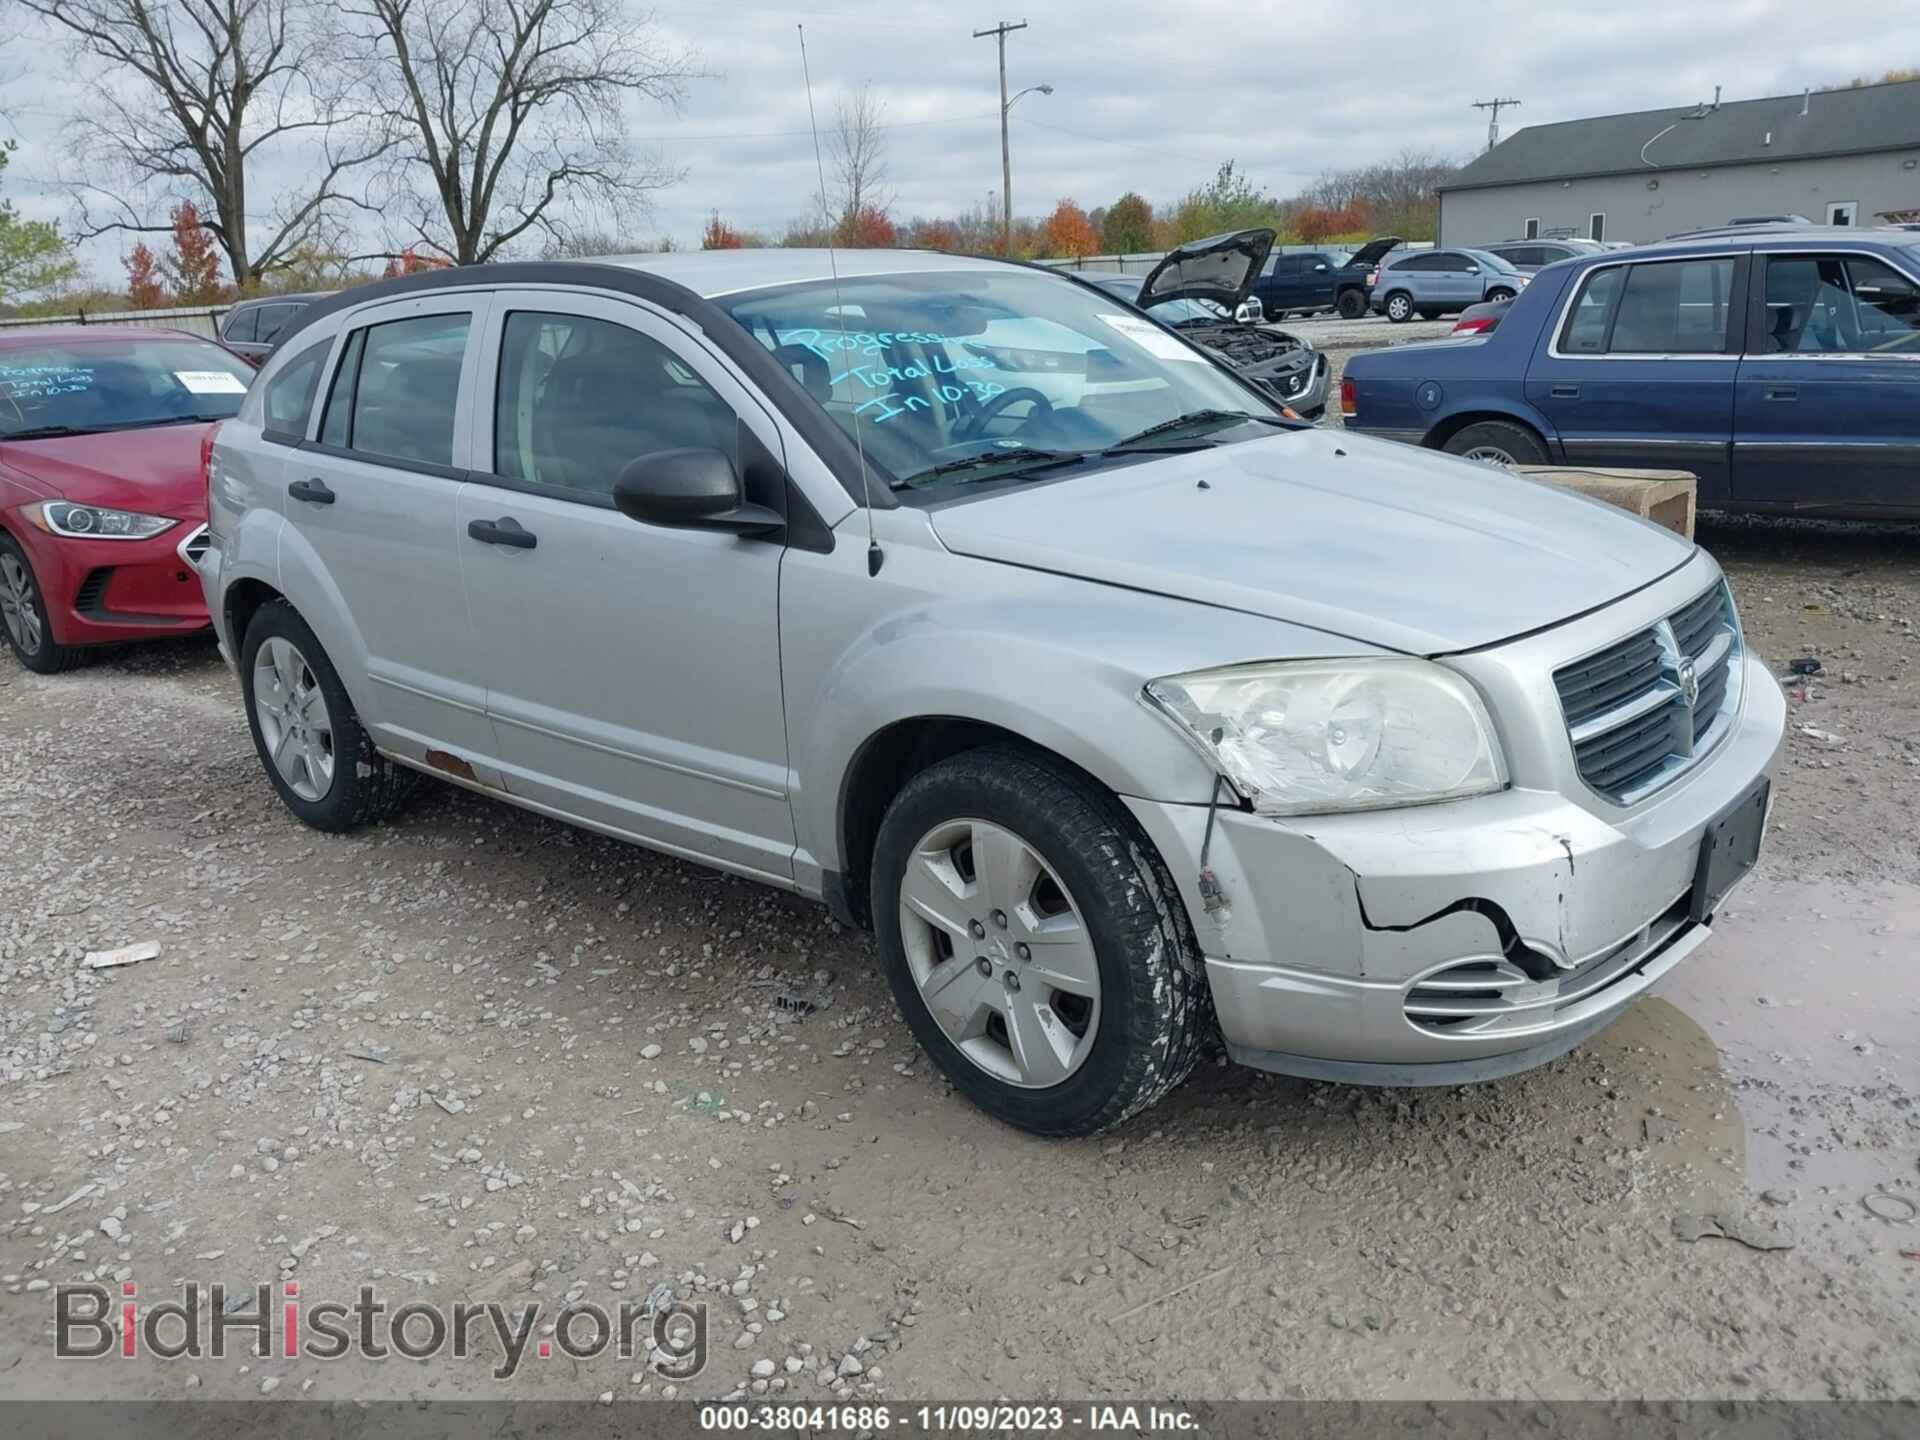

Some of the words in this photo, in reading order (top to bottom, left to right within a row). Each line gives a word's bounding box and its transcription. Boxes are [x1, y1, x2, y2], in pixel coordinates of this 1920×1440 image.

[783, 329, 987, 362] Progress
[830, 359, 932, 388] Total
[934, 355, 995, 373] Loss
[856, 393, 930, 423] In
